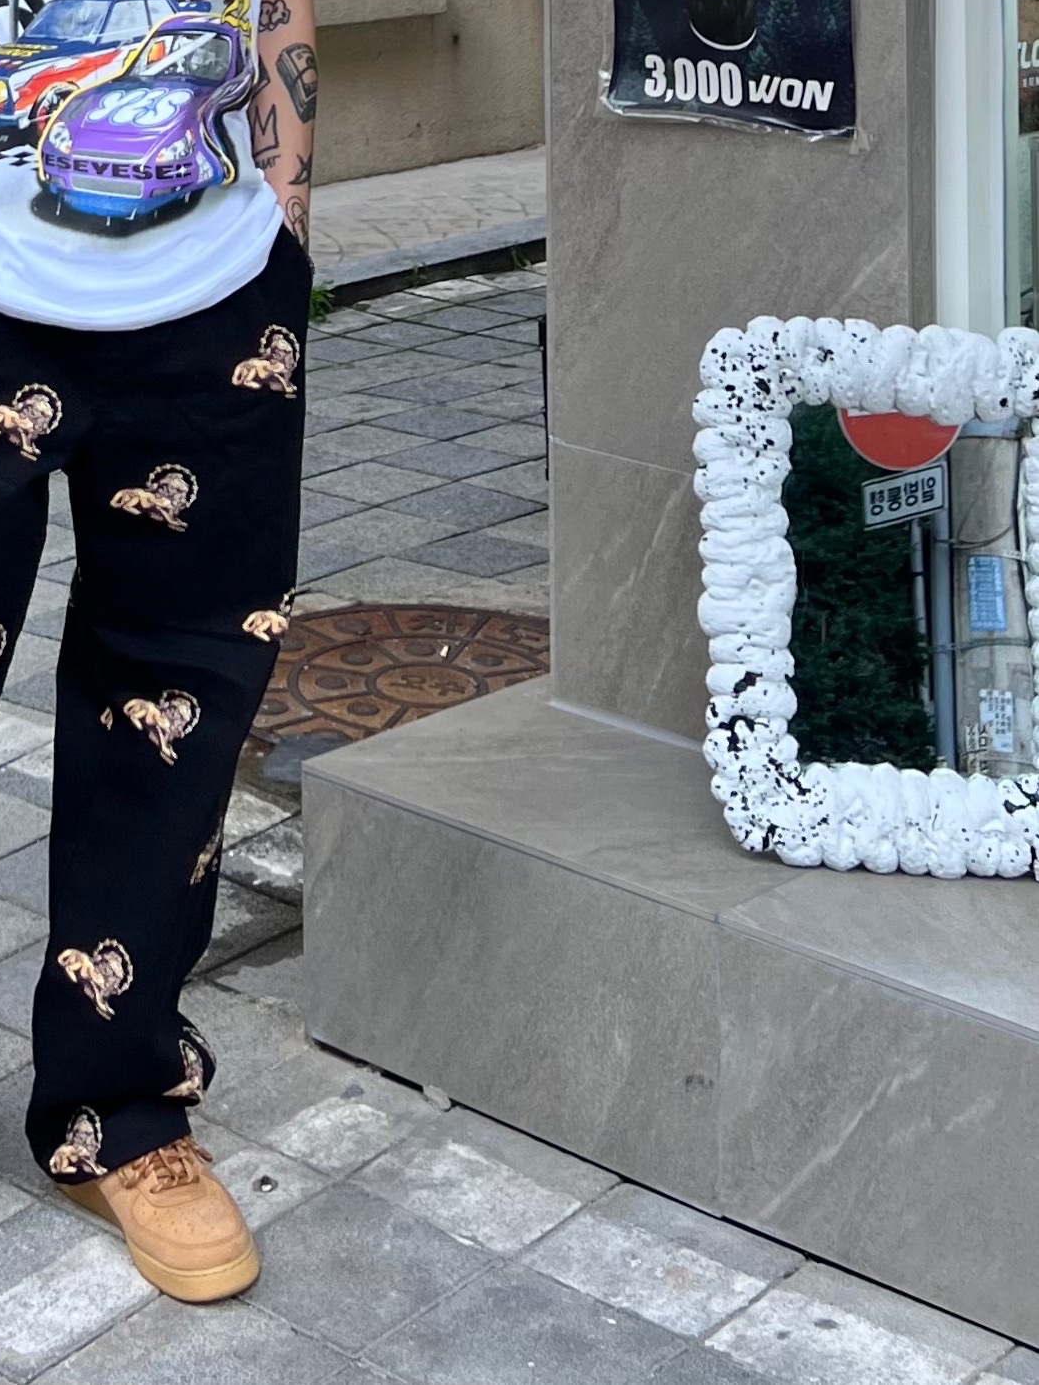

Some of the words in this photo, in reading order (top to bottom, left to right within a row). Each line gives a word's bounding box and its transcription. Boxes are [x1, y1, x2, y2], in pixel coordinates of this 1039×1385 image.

[644, 53, 743, 107] 3,000
[748, 73, 835, 112] WON
[86, 87, 195, 127] YES
[41, 152, 193, 180] ESEYESEE
